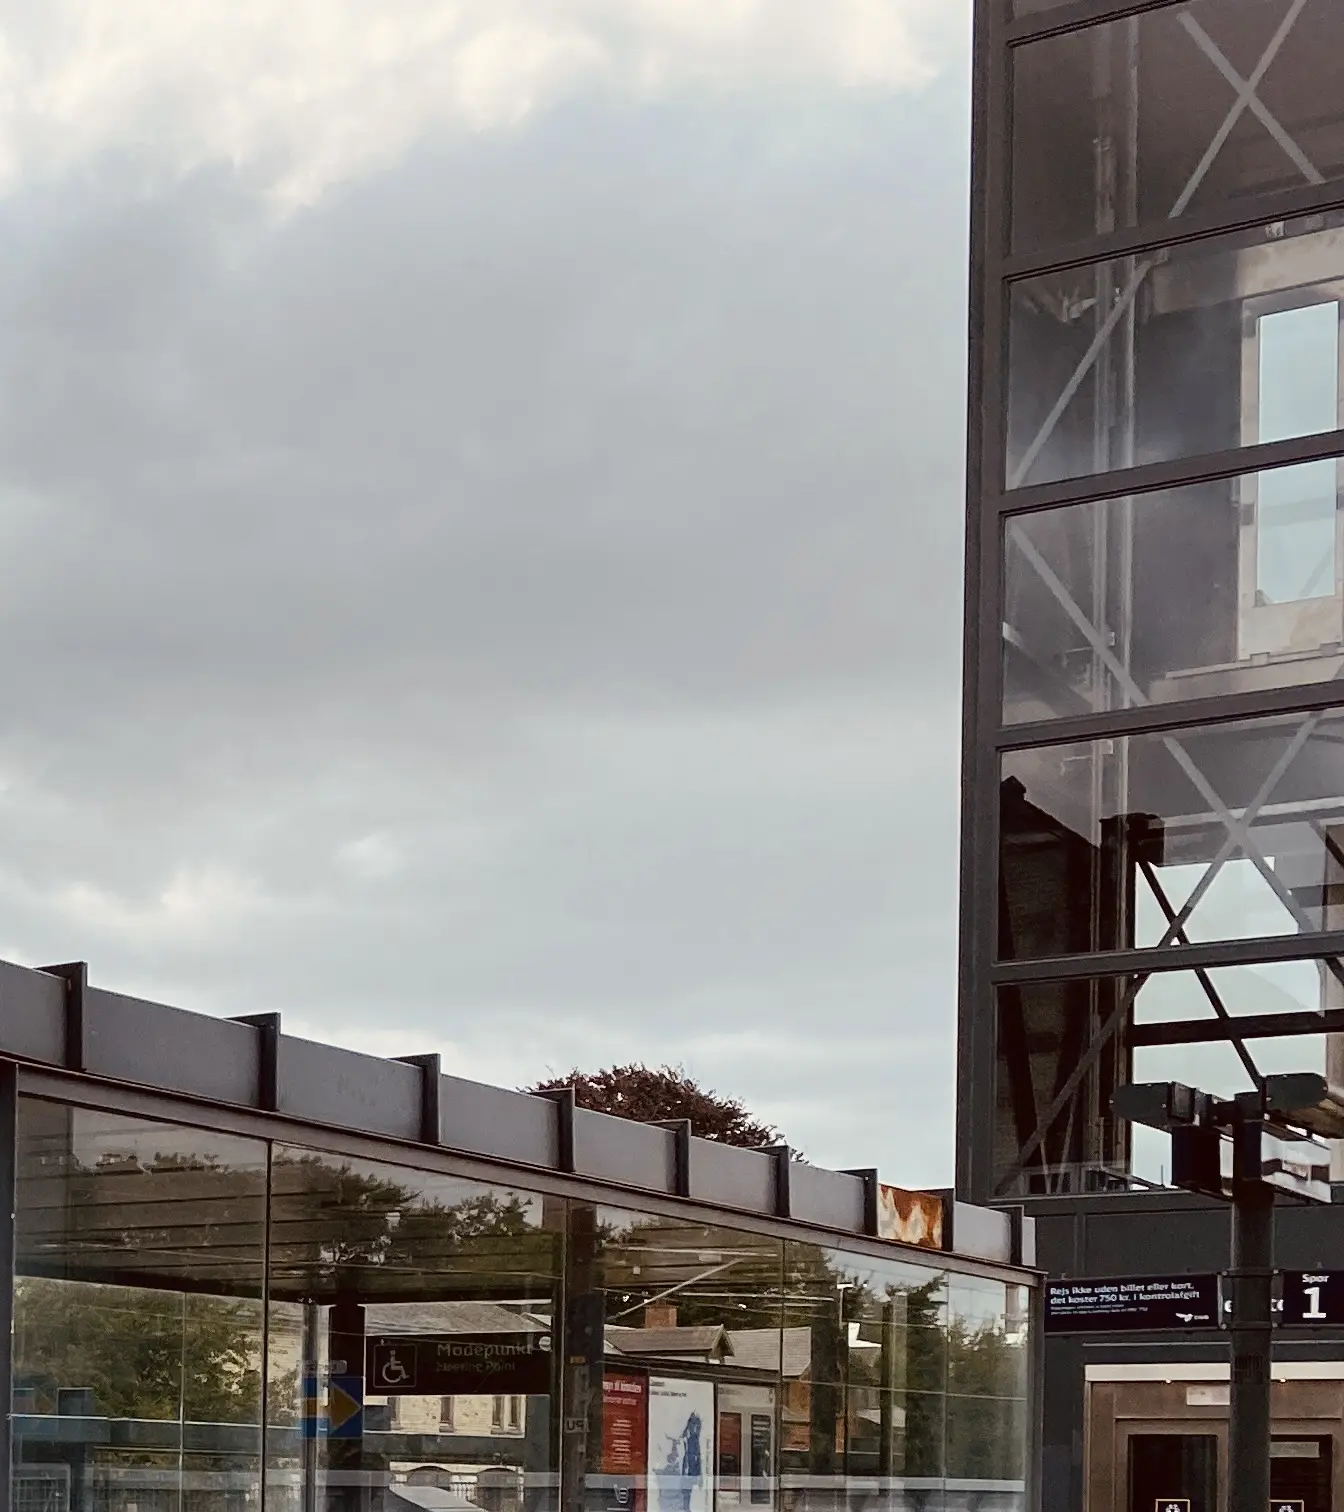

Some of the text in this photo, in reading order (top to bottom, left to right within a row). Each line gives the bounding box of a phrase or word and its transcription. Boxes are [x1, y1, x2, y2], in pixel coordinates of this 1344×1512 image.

[1302, 1273, 1330, 1284] Spor
[1050, 1287, 1069, 1296] Rejs
[1099, 1294, 1117, 1303] 750
[1302, 1286, 1327, 1319] 1
